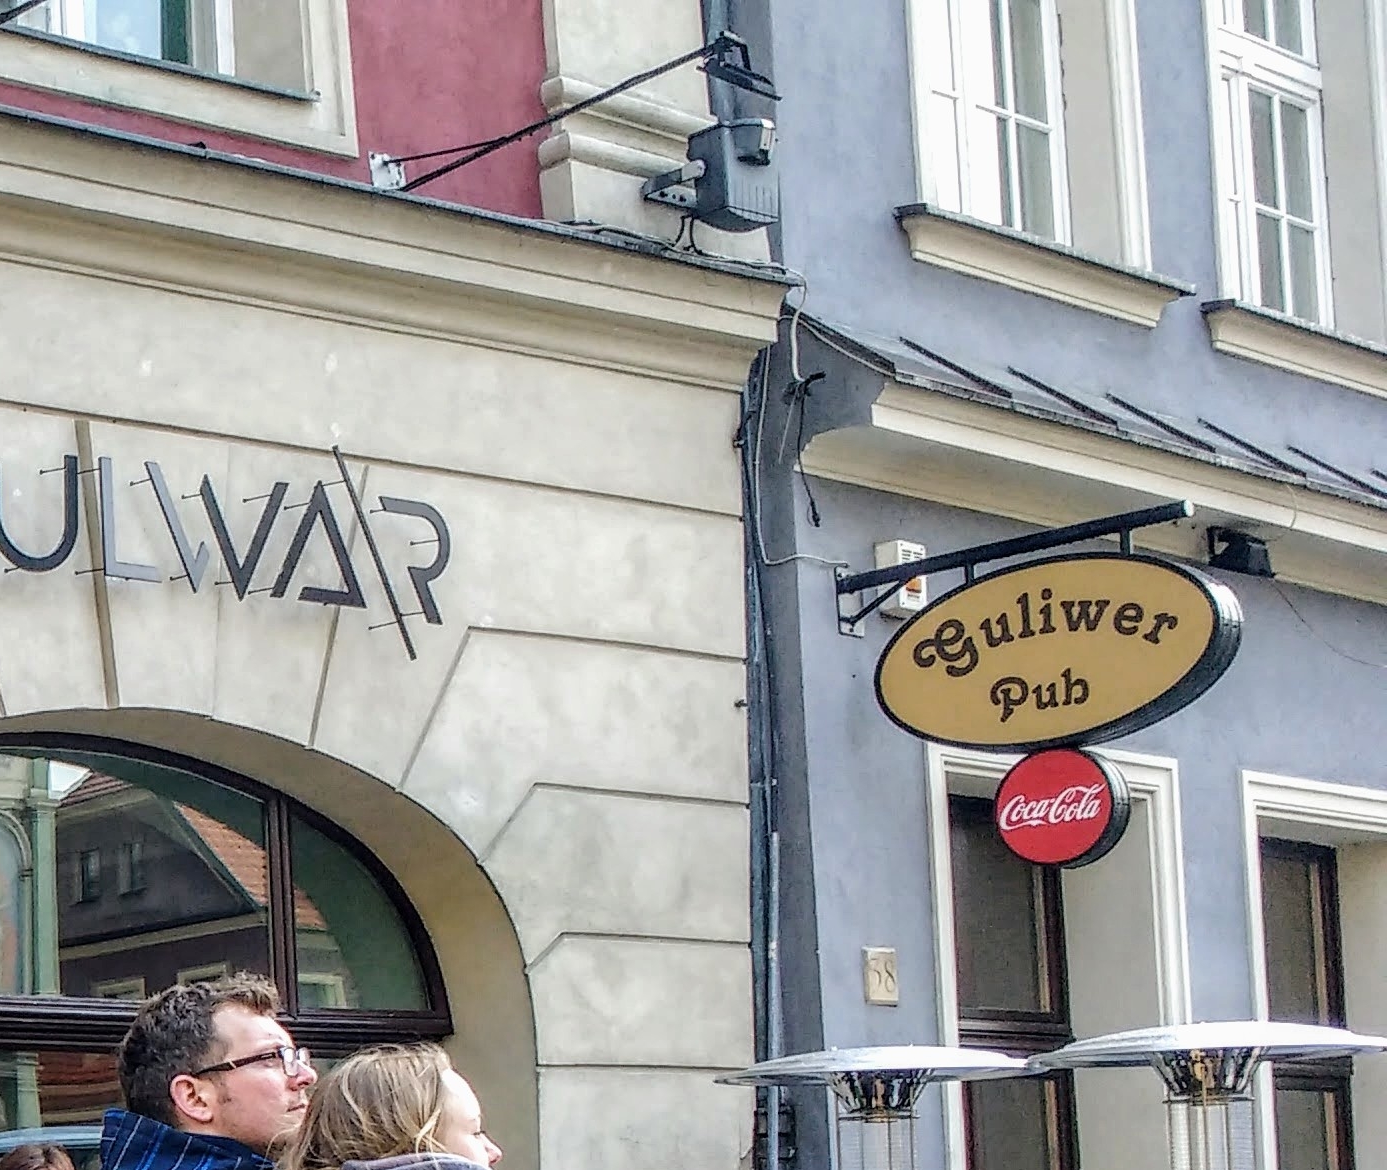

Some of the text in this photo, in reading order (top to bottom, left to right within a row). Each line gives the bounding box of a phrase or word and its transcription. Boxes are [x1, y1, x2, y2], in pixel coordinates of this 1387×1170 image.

[913, 588, 1178, 677] Guliwer
[990, 668, 1090, 722] Pub
[999, 784, 1105, 831] Coca-Cola
